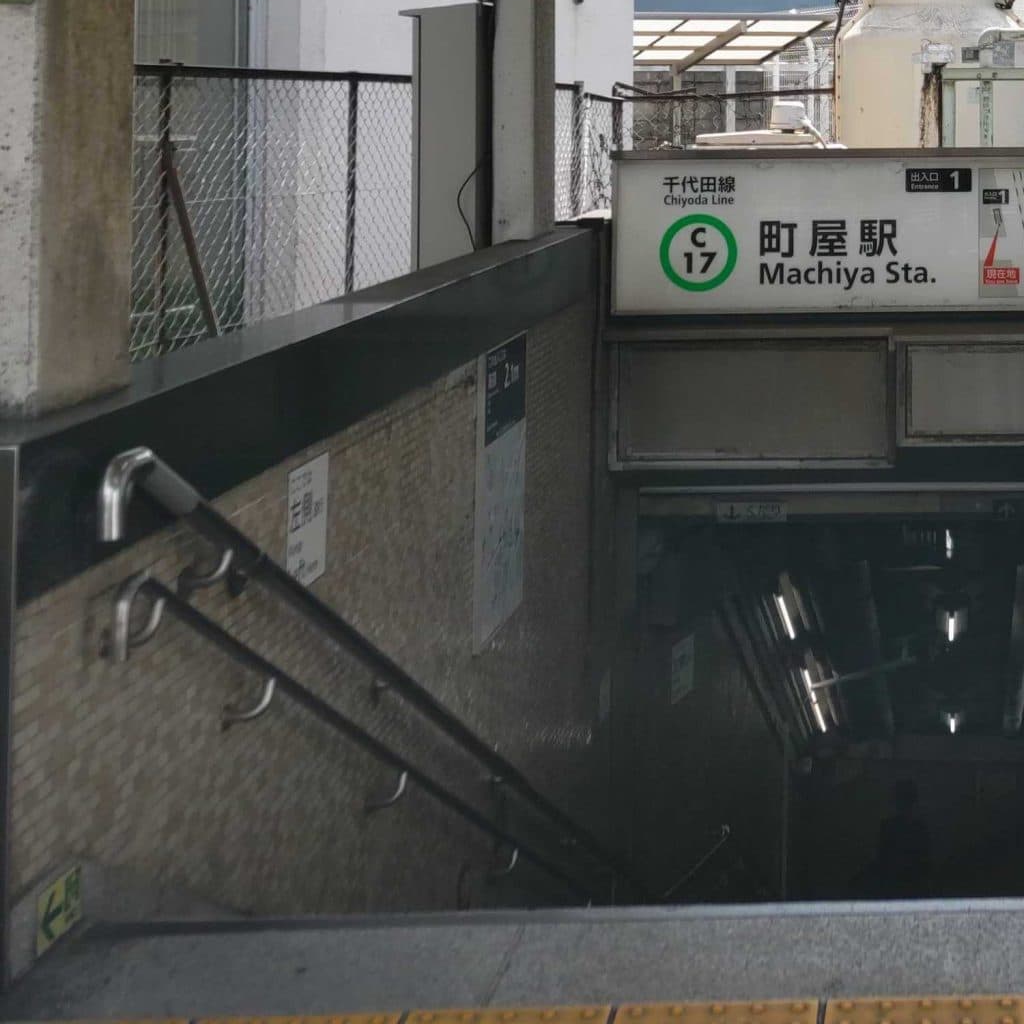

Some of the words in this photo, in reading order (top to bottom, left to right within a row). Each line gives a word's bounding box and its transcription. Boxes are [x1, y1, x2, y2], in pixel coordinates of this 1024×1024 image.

[662, 175, 736, 193] 千代田線
[911, 172, 939, 182] 出入口
[949, 170, 959, 190] 1
[663, 194, 708, 208] Chiyoda
[711, 194, 735, 205] Line
[999, 190, 1006, 204] 1
[690, 227, 706, 249] C
[759, 219, 898, 258] 町屋駅
[683, 252, 717, 274] 17
[759, 261, 875, 290] Machiya
[885, 261, 936, 285] Sta.
[986, 269, 1016, 279] 現在地
